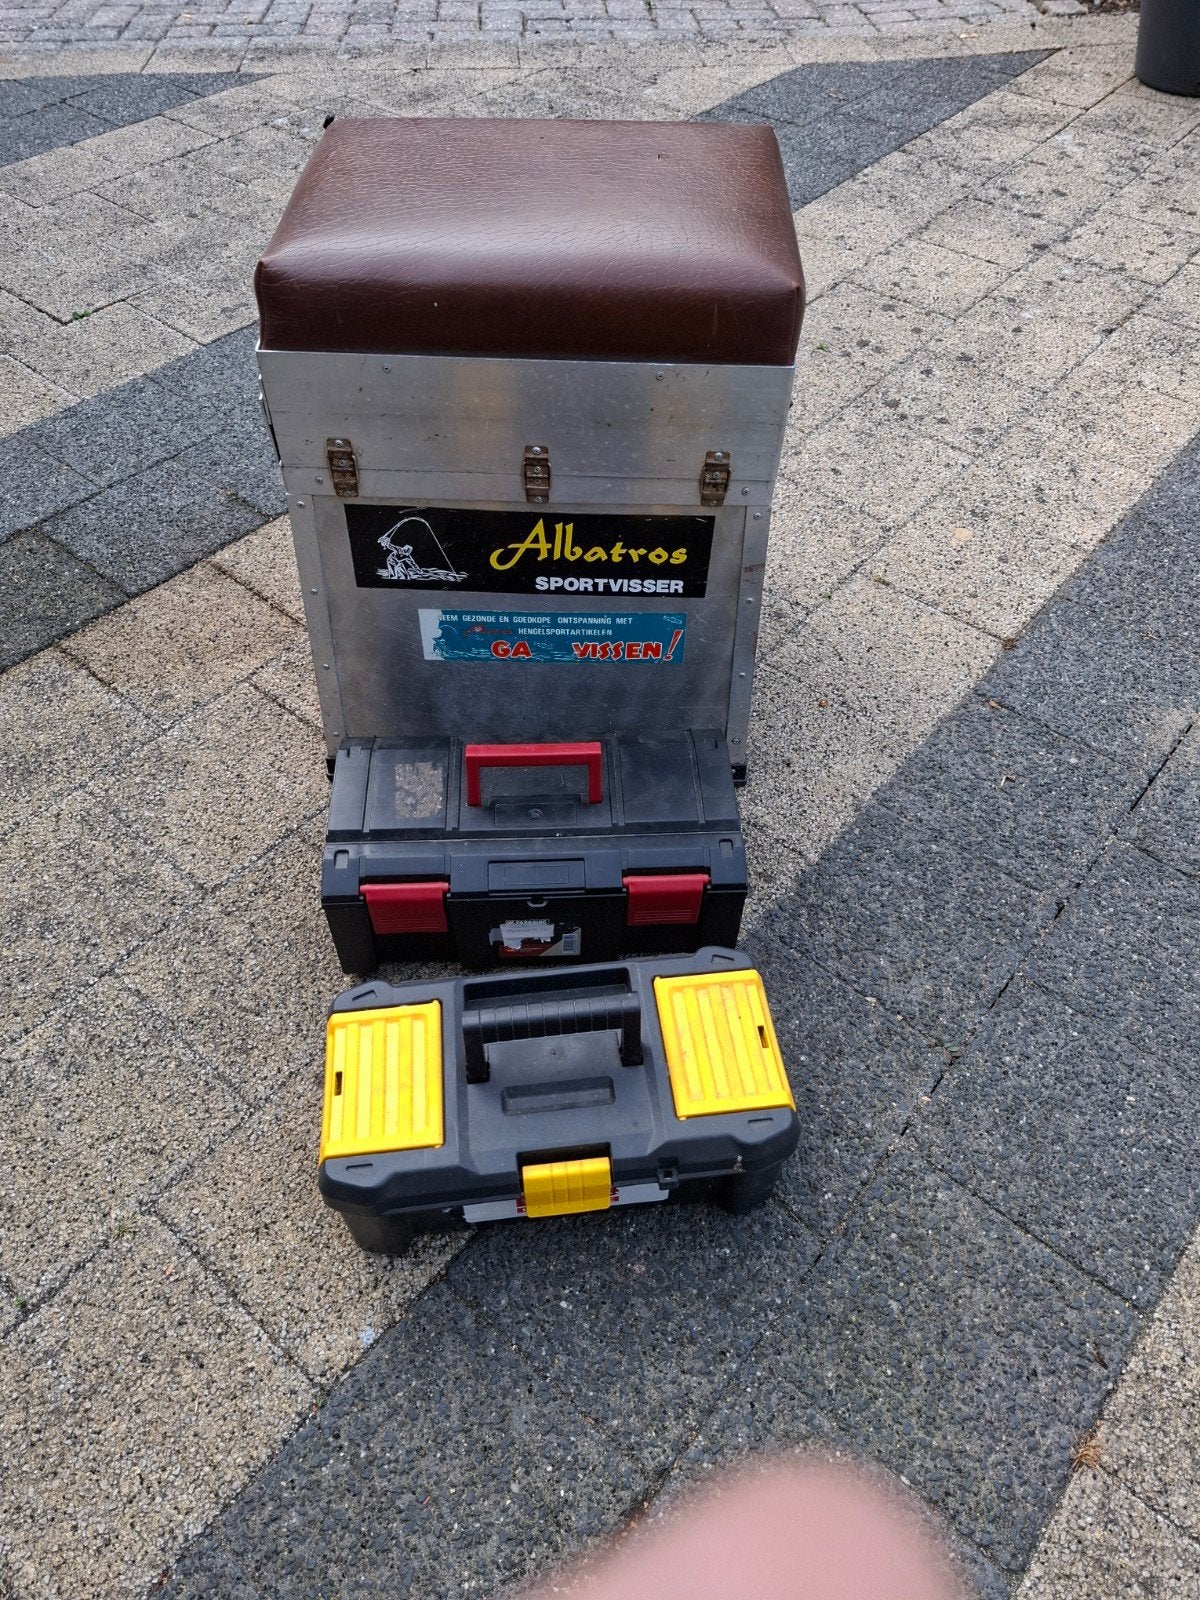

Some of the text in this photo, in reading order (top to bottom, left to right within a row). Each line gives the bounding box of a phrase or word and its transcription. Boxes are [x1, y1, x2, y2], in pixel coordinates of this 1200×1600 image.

[490, 518, 688, 571] Albatros
[535, 576, 684, 594] SPORTVISSER
[462, 614, 497, 623] GEZONDE
[499, 615, 510, 623] EN
[513, 616, 551, 624] GOEDKOPE
[557, 616, 612, 625] ONTSPANNING
[615, 617, 633, 625] MET
[518, 628, 613, 636] HENGELSPORTARTIKELEN
[491, 629, 683, 661] GA VISSEN!
